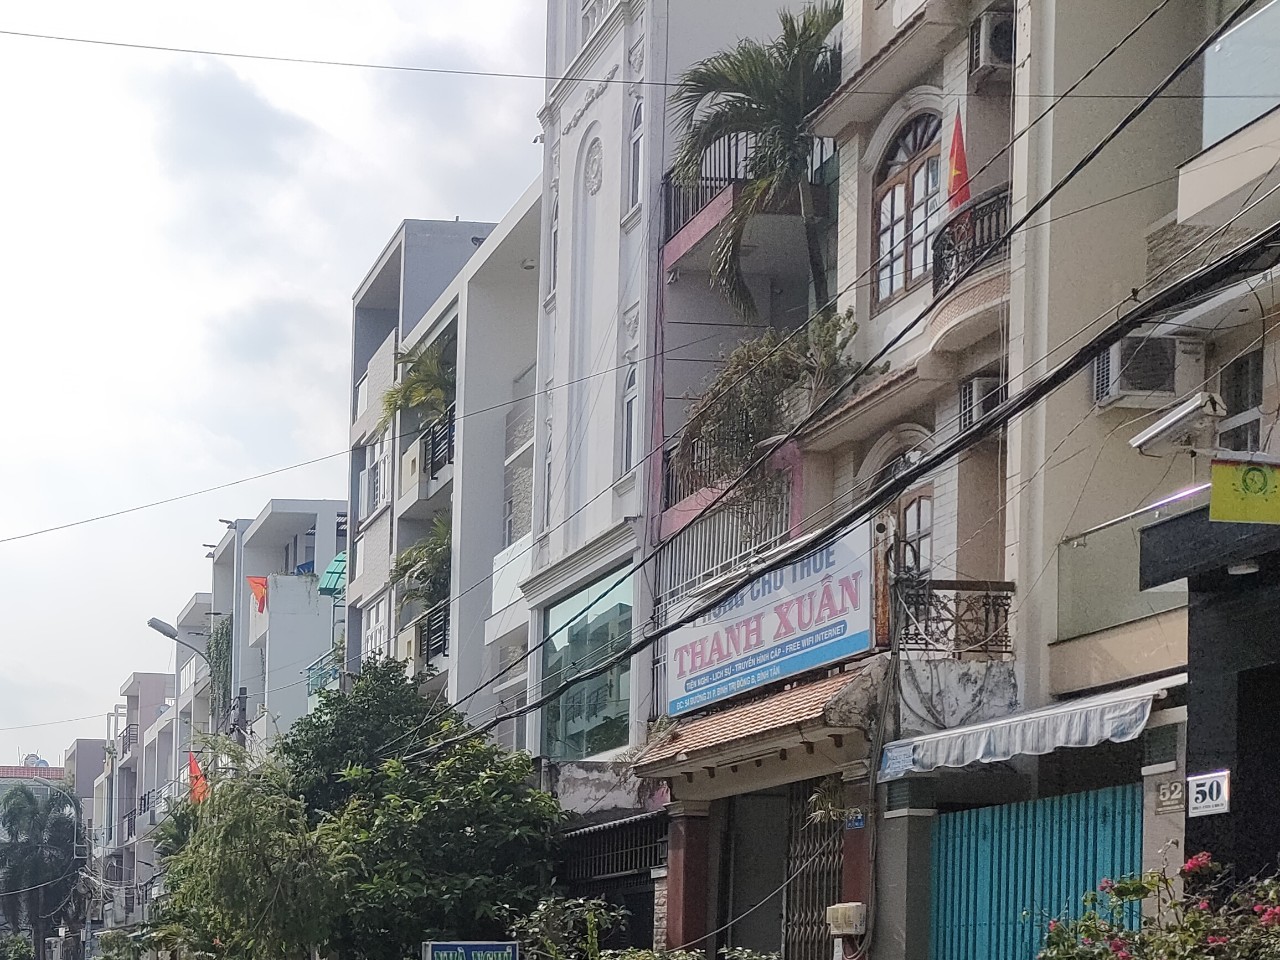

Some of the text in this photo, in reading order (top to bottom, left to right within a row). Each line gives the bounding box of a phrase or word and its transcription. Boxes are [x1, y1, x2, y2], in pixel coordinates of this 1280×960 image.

[673, 570, 863, 680] THANH XUÂN
[785, 641, 801, 654] FREE
[801, 637, 814, 648] WIFI
[814, 624, 845, 644] INTERNET
[1159, 782, 1183, 801] 52
[1194, 780, 1222, 804] 50
